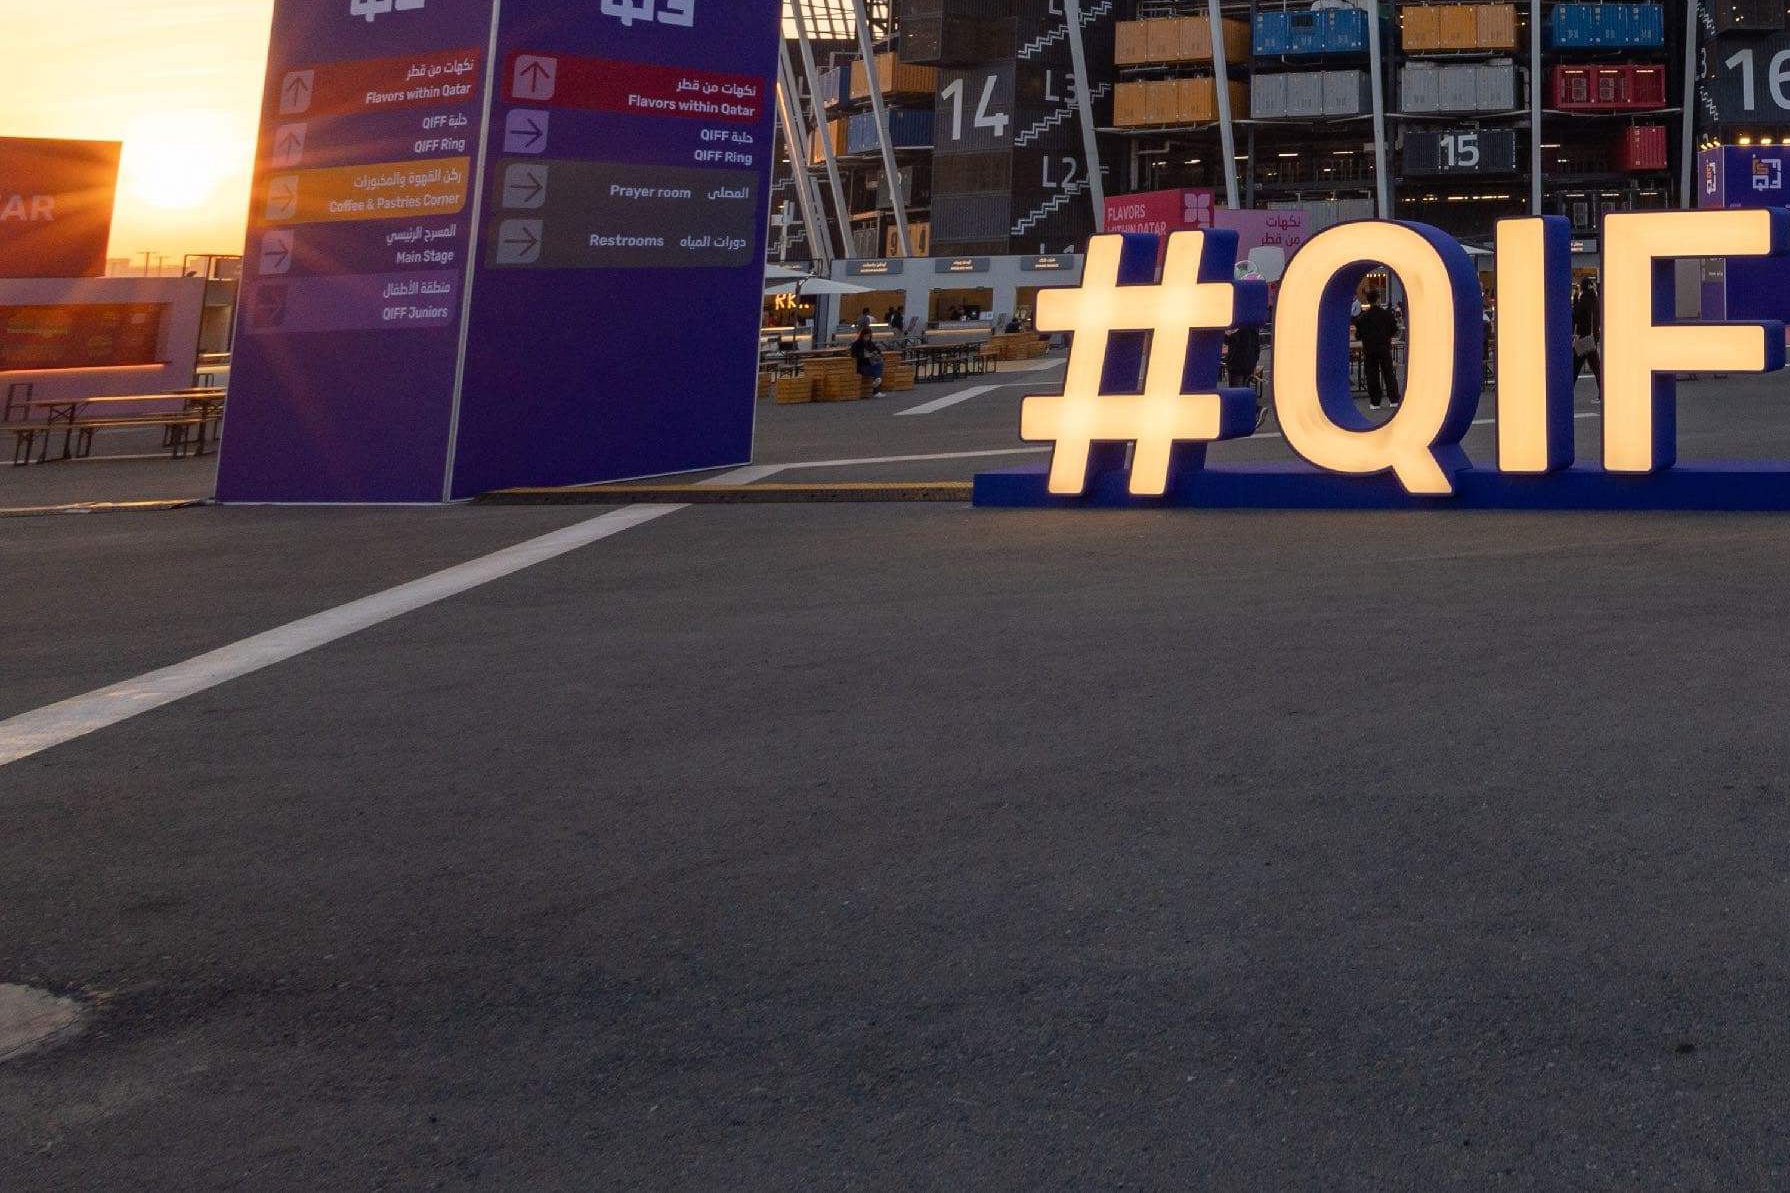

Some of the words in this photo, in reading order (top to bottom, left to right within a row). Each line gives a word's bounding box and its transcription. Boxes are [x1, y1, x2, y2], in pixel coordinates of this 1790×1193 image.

[406, 64, 426, 81] قطر
[428, 66, 441, 77] من
[676, 78, 700, 92] قطر
[702, 82, 719, 94] من
[1044, 69, 1078, 103] L3
[366, 90, 404, 104] Flavors
[406, 87, 440, 101] within
[442, 84, 471, 97] Qatar
[628, 95, 677, 110] Flavors
[679, 99, 719, 114] within
[721, 103, 755, 117] Qatar
[941, 75, 1010, 141] 14
[422, 115, 447, 129] QIFF
[701, 129, 729, 142] QIFF
[415, 140, 438, 153] QIFF
[441, 139, 465, 152] Ring
[1440, 134, 1480, 167] 15
[694, 150, 722, 162] QIFF
[724, 151, 753, 166] Ring
[1041, 156, 1077, 188] L2
[610, 184, 655, 199] Prayer
[657, 188, 691, 198] room
[0, 193, 55, 221] AR
[329, 199, 364, 213] Coffee
[366, 198, 374, 209] &
[377, 195, 421, 209] Pastries
[423, 194, 460, 206] Corner
[1108, 204, 1146, 221] FLAVORS
[590, 234, 664, 247] Restrooms
[1261, 232, 1282, 247] قطر
[1286, 234, 1301, 245] من
[396, 251, 422, 264] Main
[424, 250, 454, 265] Stage
[382, 307, 407, 320] QIFF
[408, 306, 448, 318] Juniors
